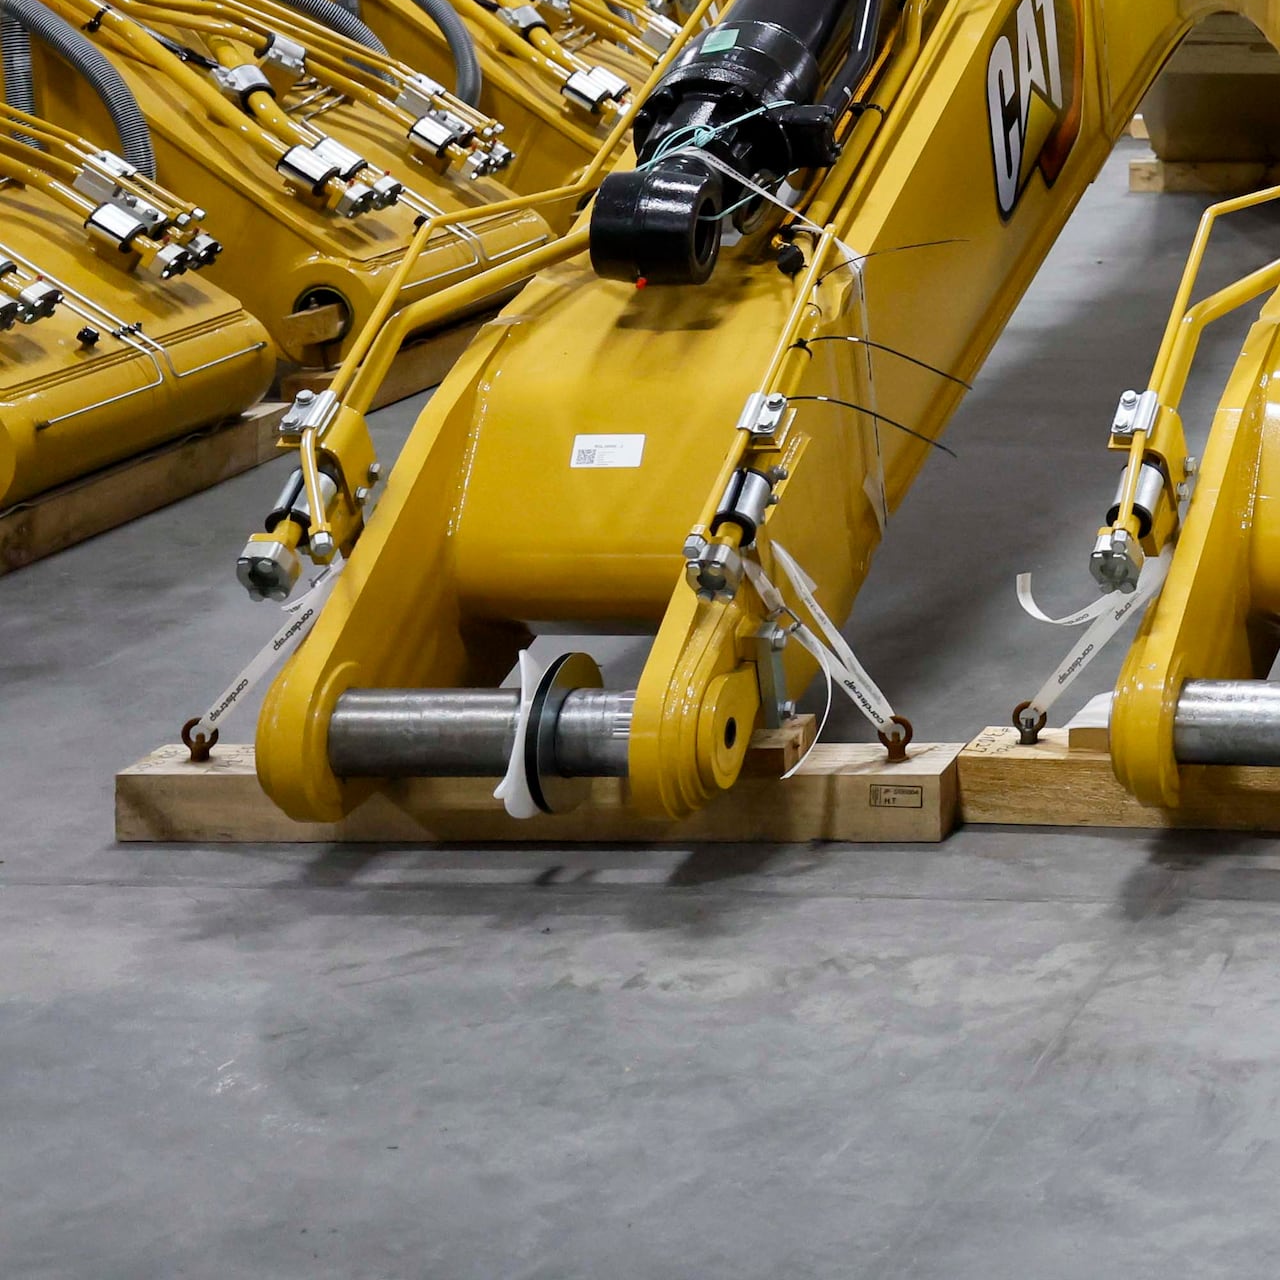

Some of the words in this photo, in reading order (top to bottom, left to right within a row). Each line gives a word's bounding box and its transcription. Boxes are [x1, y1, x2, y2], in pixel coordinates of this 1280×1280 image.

[273, 608, 314, 651] cordstrap
[1058, 643, 1094, 685] cordstrap
[209, 678, 249, 722] cordstrap
[843, 678, 885, 725] cordstrap
